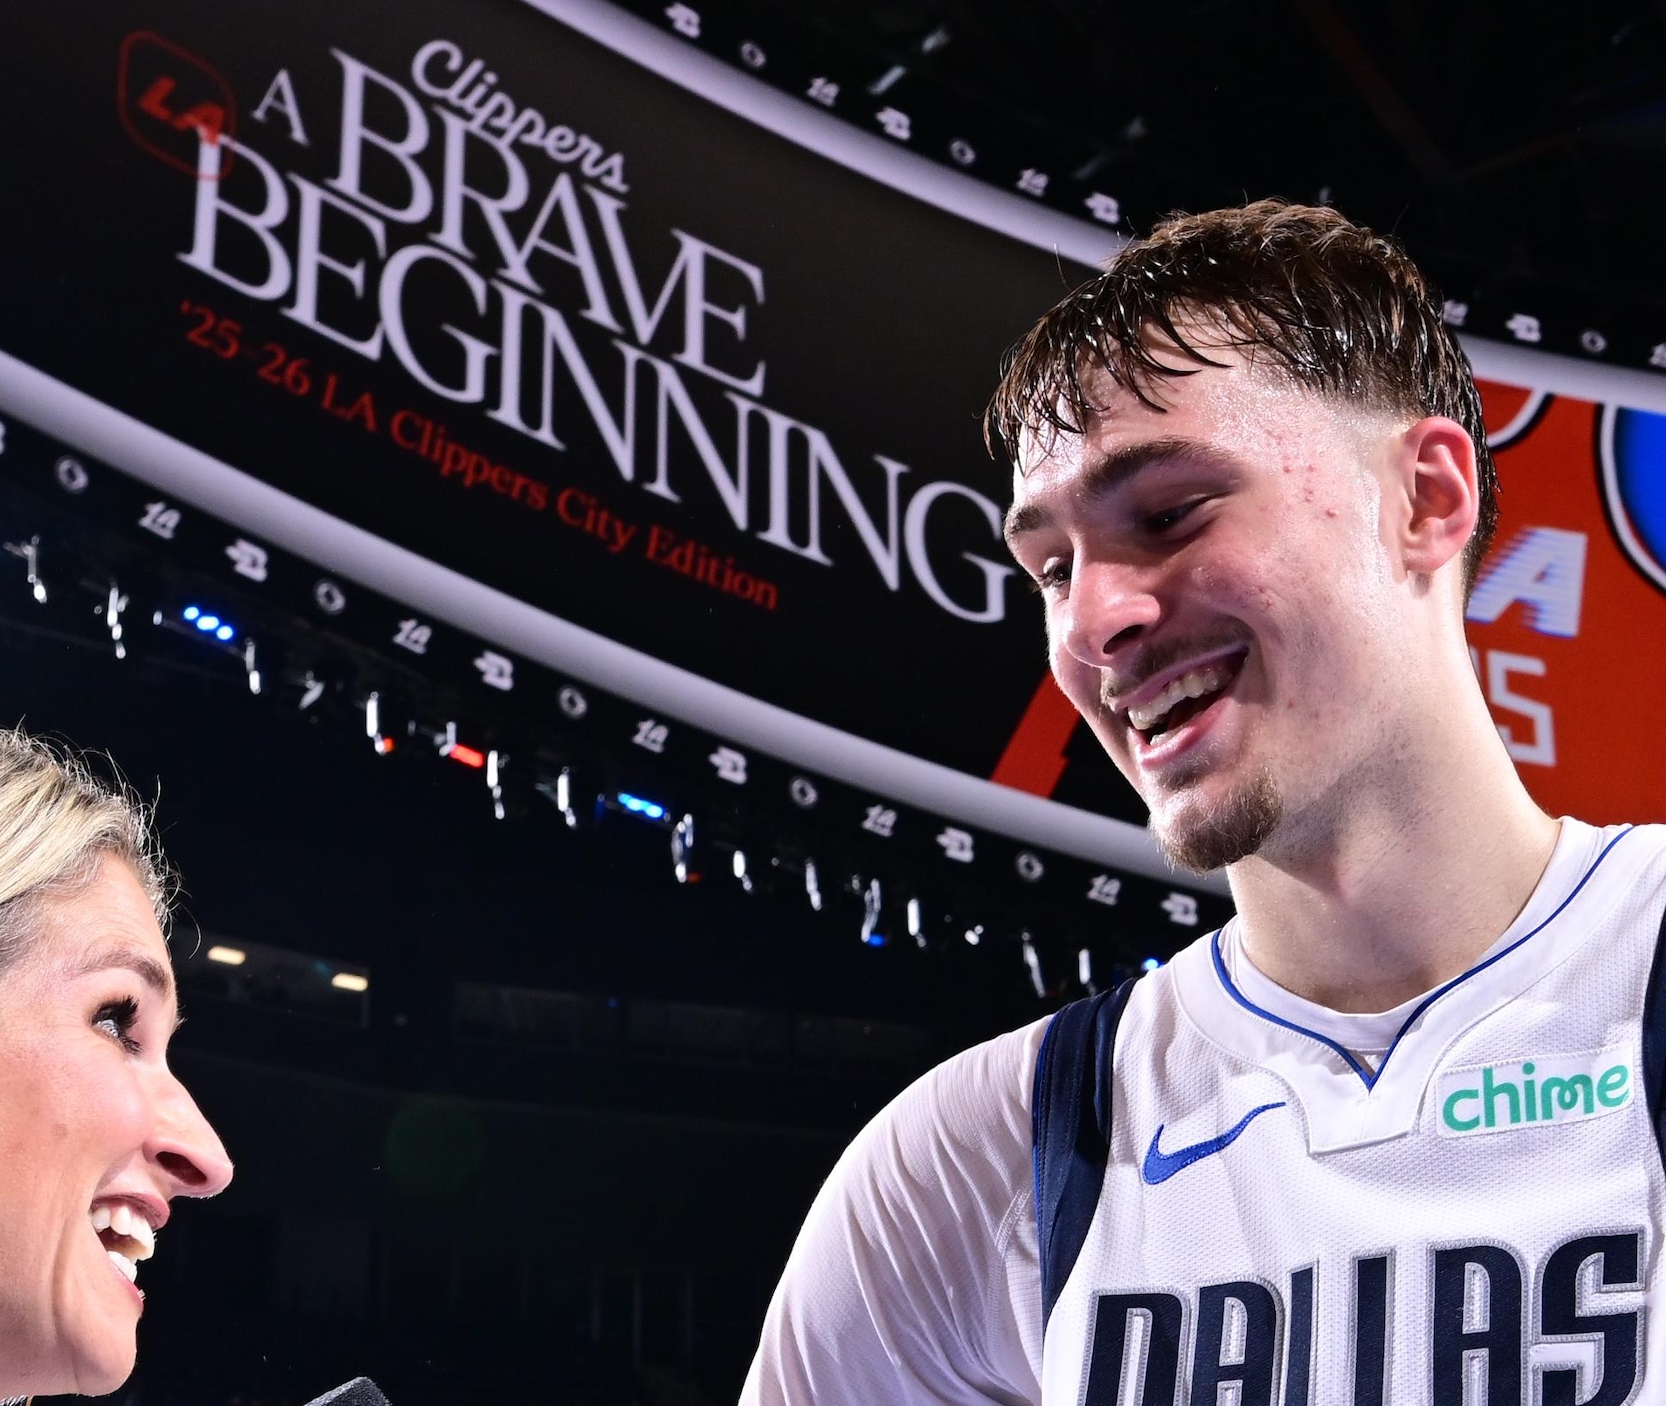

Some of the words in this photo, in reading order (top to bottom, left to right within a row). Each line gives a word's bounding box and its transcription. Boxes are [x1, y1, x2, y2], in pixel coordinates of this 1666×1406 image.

[139, 76, 226, 146] LA
[412, 39, 630, 193] Clippers
[251, 67, 310, 147] A
[326, 46, 766, 398] BRAVE
[176, 123, 1020, 624] BEGINNING
[180, 299, 312, 397] '25-26
[321, 371, 377, 433] LA
[389, 409, 550, 510] Clippers
[556, 487, 636, 554] City
[645, 524, 780, 611] Edition
[1465, 526, 1588, 640] A
[1469, 645, 1557, 768] 5
[1442, 1061, 1630, 1132] chime
